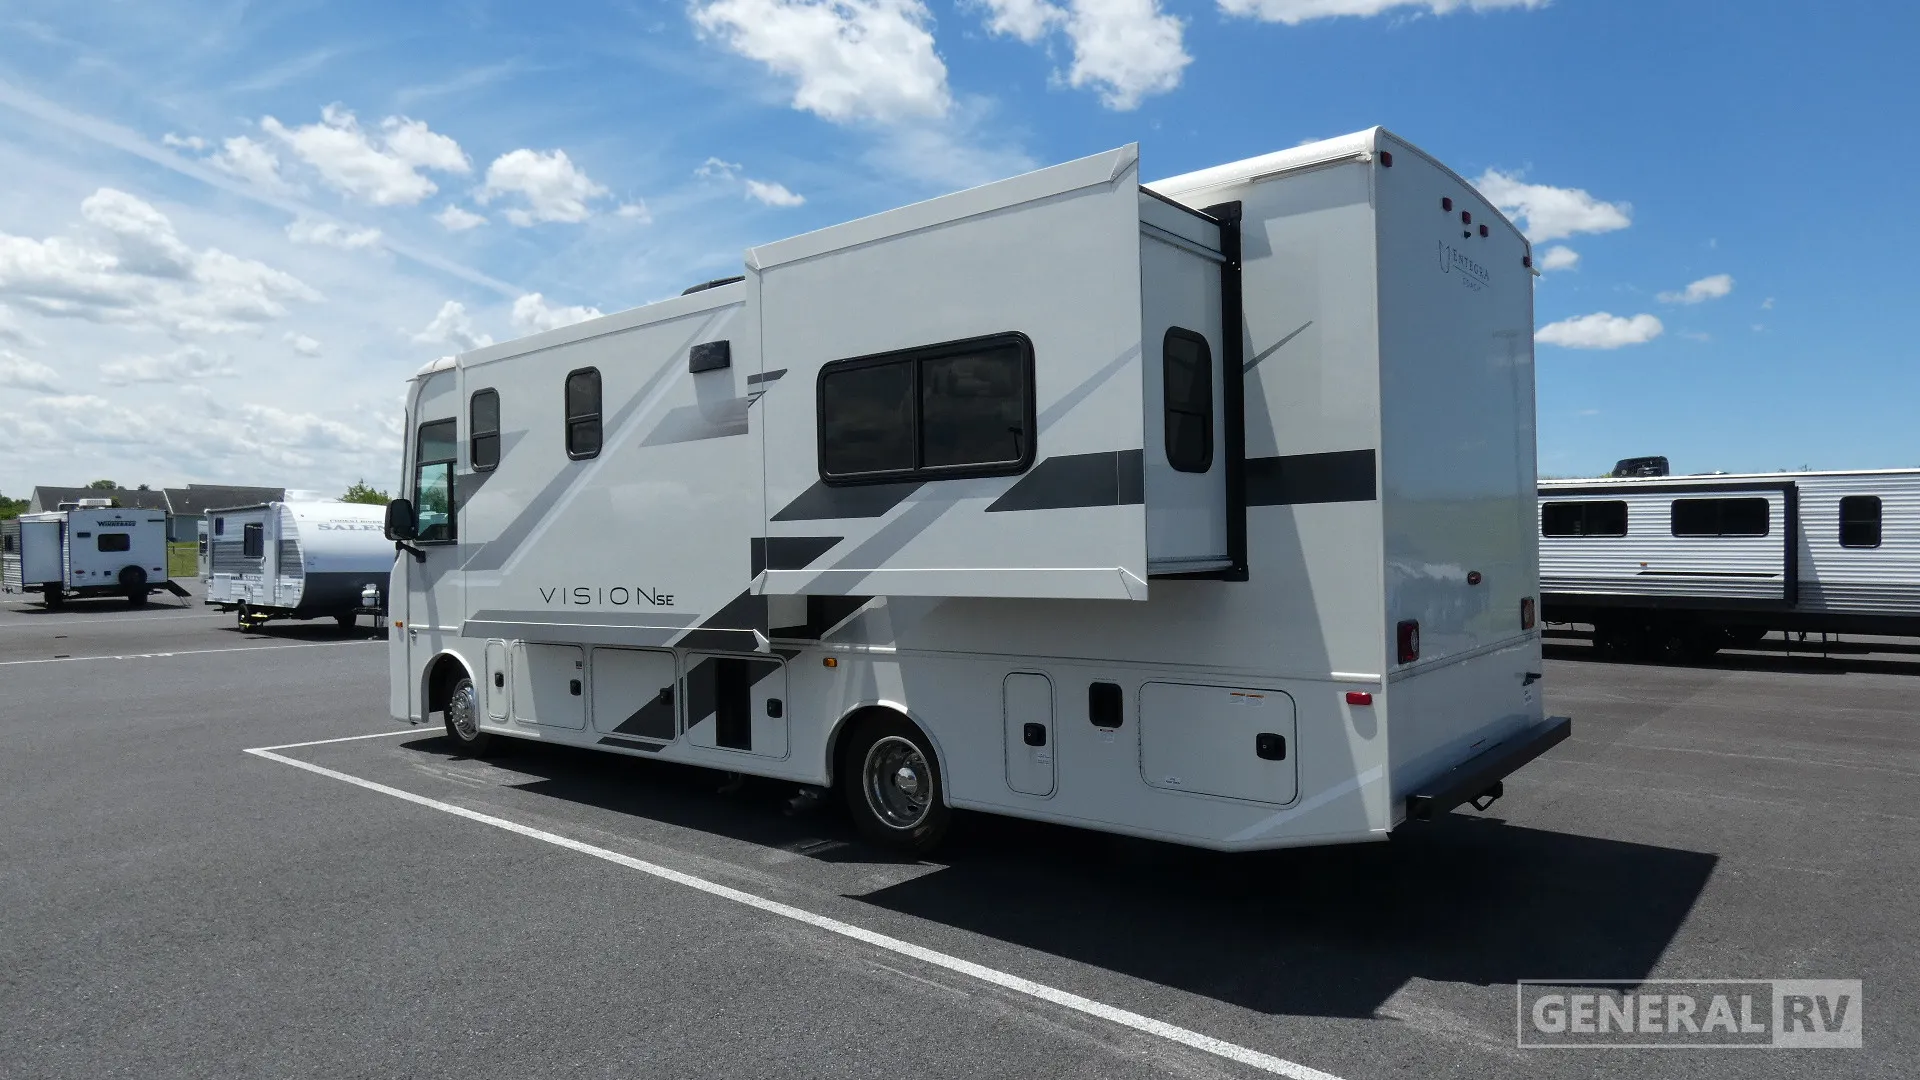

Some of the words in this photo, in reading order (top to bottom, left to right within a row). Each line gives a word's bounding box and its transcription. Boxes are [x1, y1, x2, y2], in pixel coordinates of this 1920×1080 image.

[1453, 248, 1490, 281] ENTEGRA
[539, 587, 656, 605] VISION
[656, 595, 675, 606] SE
